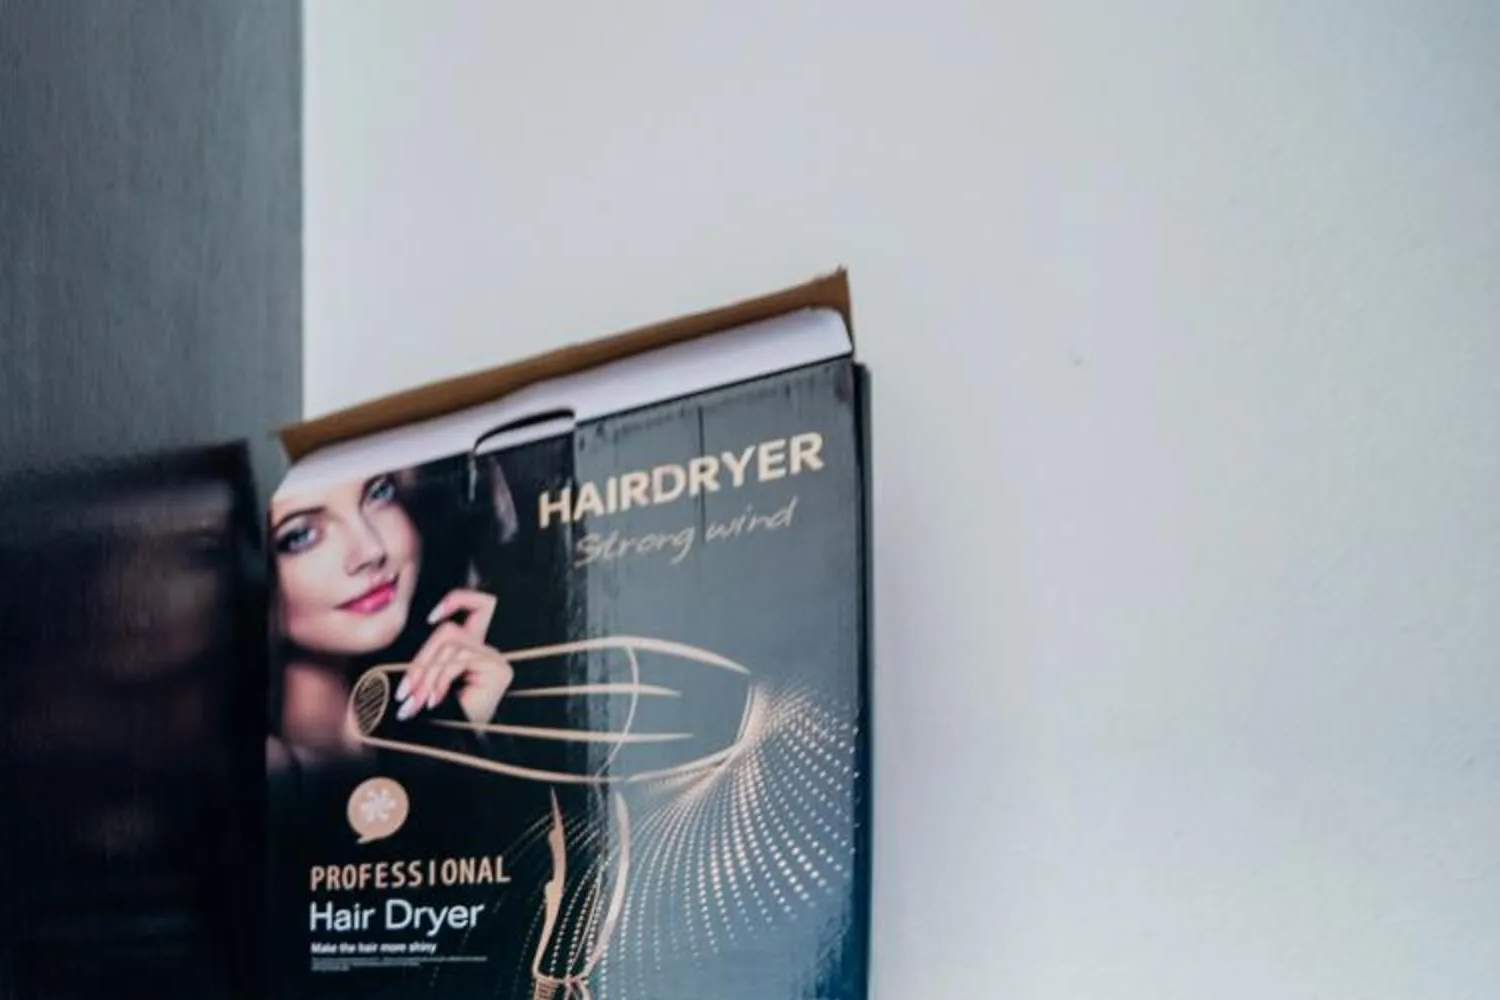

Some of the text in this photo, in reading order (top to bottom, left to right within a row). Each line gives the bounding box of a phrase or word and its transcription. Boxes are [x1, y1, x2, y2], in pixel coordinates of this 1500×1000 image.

[539, 431, 825, 529] HAIRDRYER
[573, 496, 798, 568] Strong wind
[309, 855, 512, 891] PROFESSIONAL
[309, 898, 485, 937] Hair Dryer
[310, 942, 437, 956] Make the hair more shiny
